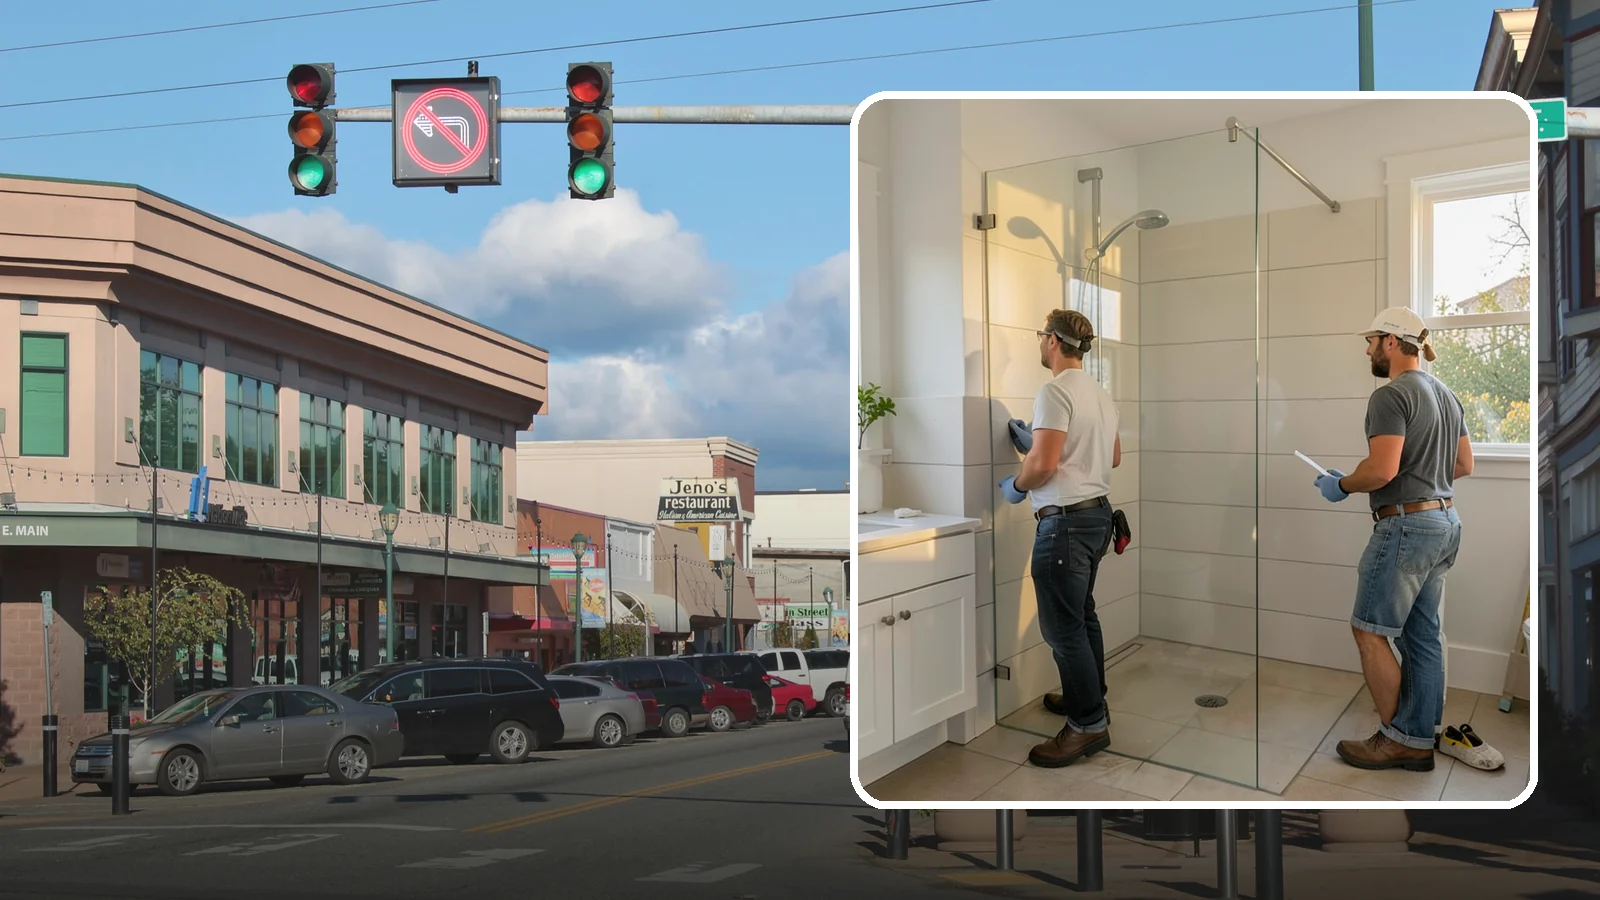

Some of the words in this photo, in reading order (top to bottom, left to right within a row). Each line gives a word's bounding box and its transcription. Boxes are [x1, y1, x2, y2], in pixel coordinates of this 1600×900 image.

[669, 480, 727, 494] Jeno's
[665, 496, 731, 509] restaurant
[658, 510, 681, 520] Italian
[685, 510, 715, 519] American
[715, 509, 738, 519] Cuisine
[2, 525, 13, 536] E.
[15, 525, 49, 536] MAIN
[797, 607, 829, 617] Street
